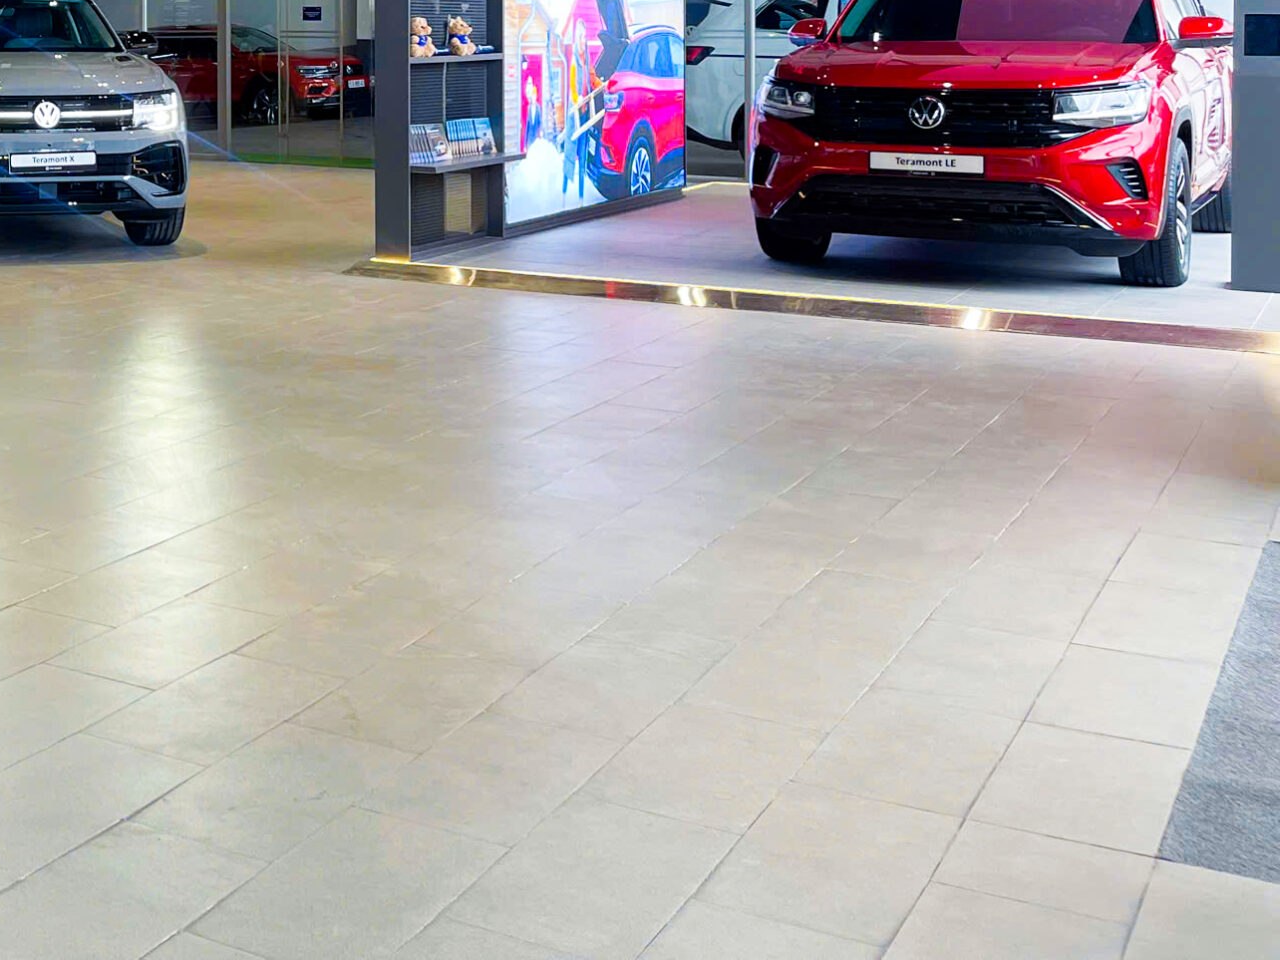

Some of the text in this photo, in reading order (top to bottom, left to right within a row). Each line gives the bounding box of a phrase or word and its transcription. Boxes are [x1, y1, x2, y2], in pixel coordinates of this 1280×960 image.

[32, 156, 67, 164] Teramont
[895, 156, 956, 168] Teramont LE
